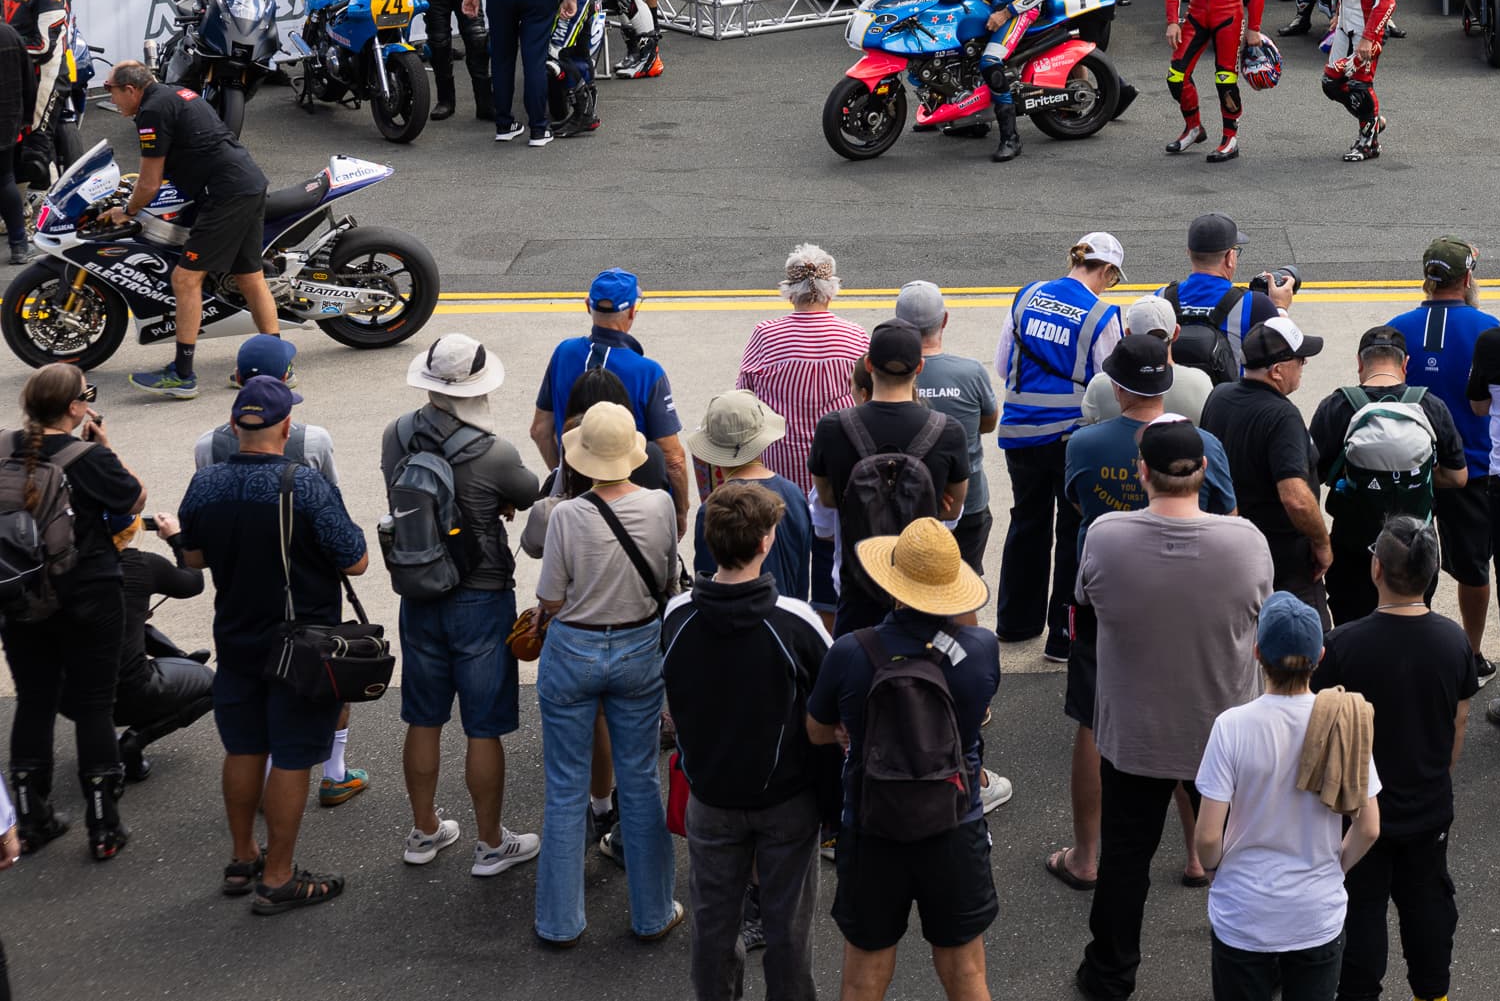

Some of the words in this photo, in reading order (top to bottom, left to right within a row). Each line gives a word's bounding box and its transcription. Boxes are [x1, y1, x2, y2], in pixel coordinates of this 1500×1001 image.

[1375, 3, 1395, 34] HONDA
[1025, 93, 1069, 109] Britten
[335, 167, 379, 183] cardion
[84, 261, 177, 307] ELECTRONIC
[304, 284, 359, 299] BATTLAX
[1028, 296, 1089, 323] NZSBK
[1025, 317, 1071, 347] MEDIA
[1100, 466, 1129, 481] OLD
[1093, 483, 1131, 511] YOUNG
